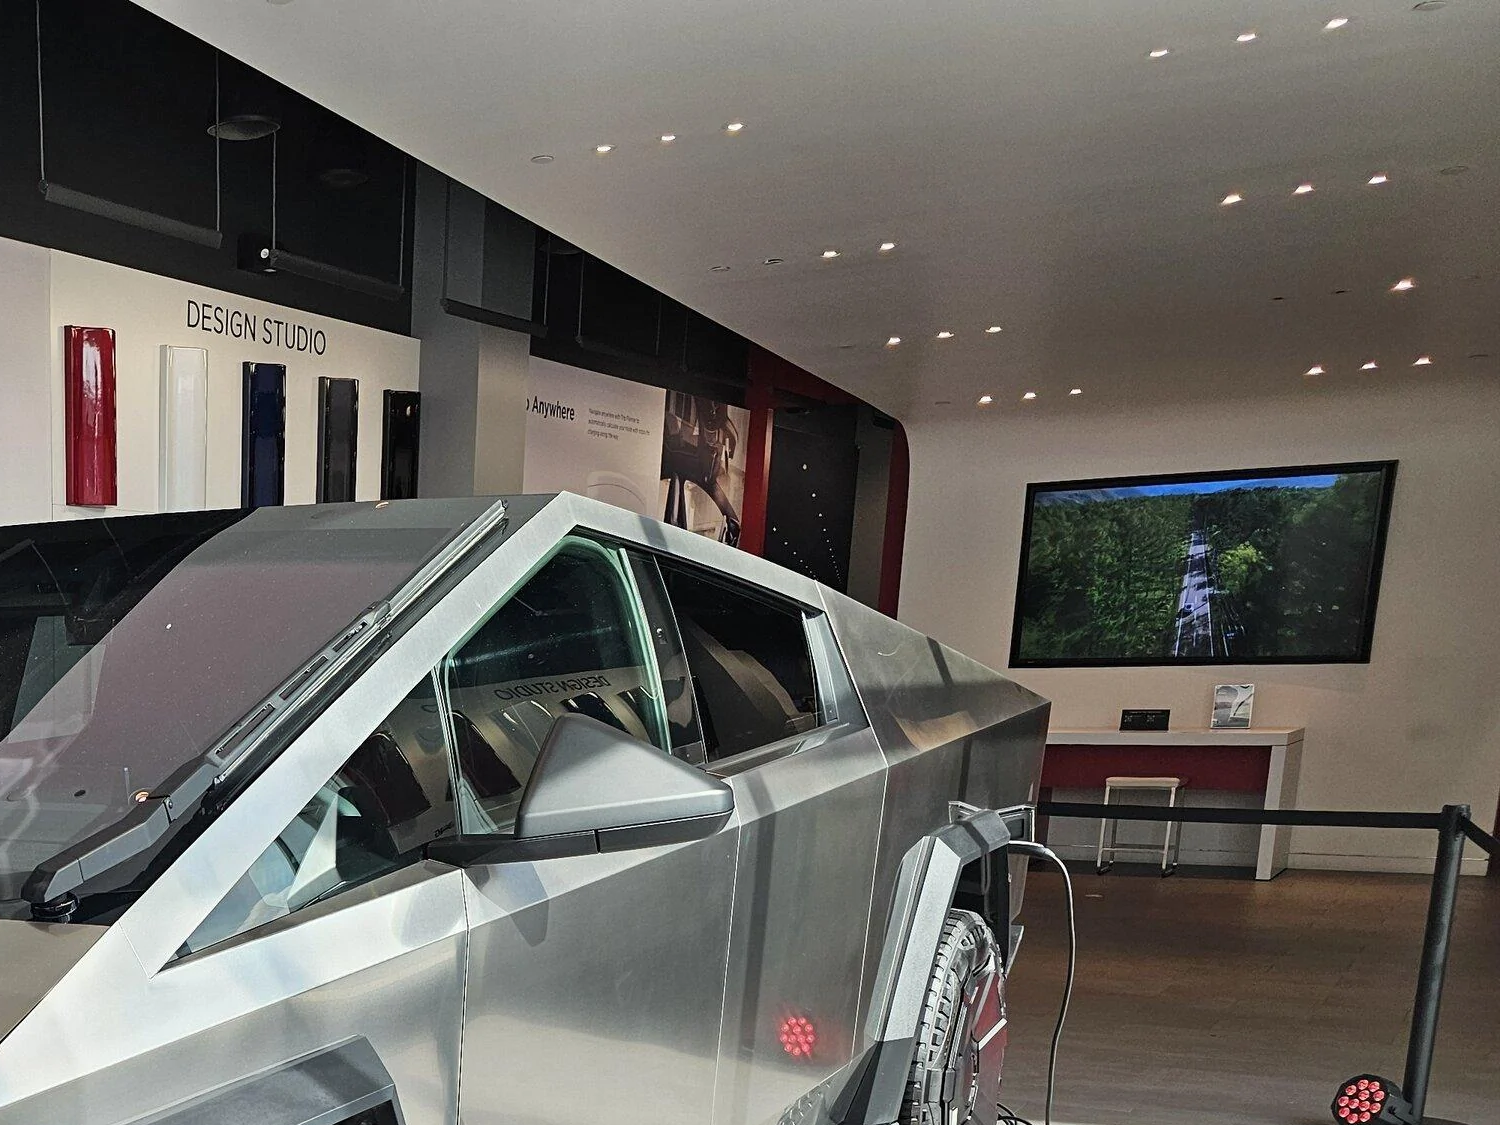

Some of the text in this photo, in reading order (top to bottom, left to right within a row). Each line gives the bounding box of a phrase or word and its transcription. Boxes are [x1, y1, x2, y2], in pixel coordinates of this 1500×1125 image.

[187, 299, 326, 356] DESIGN STUDIO
[531, 395, 575, 421] Anywhere
